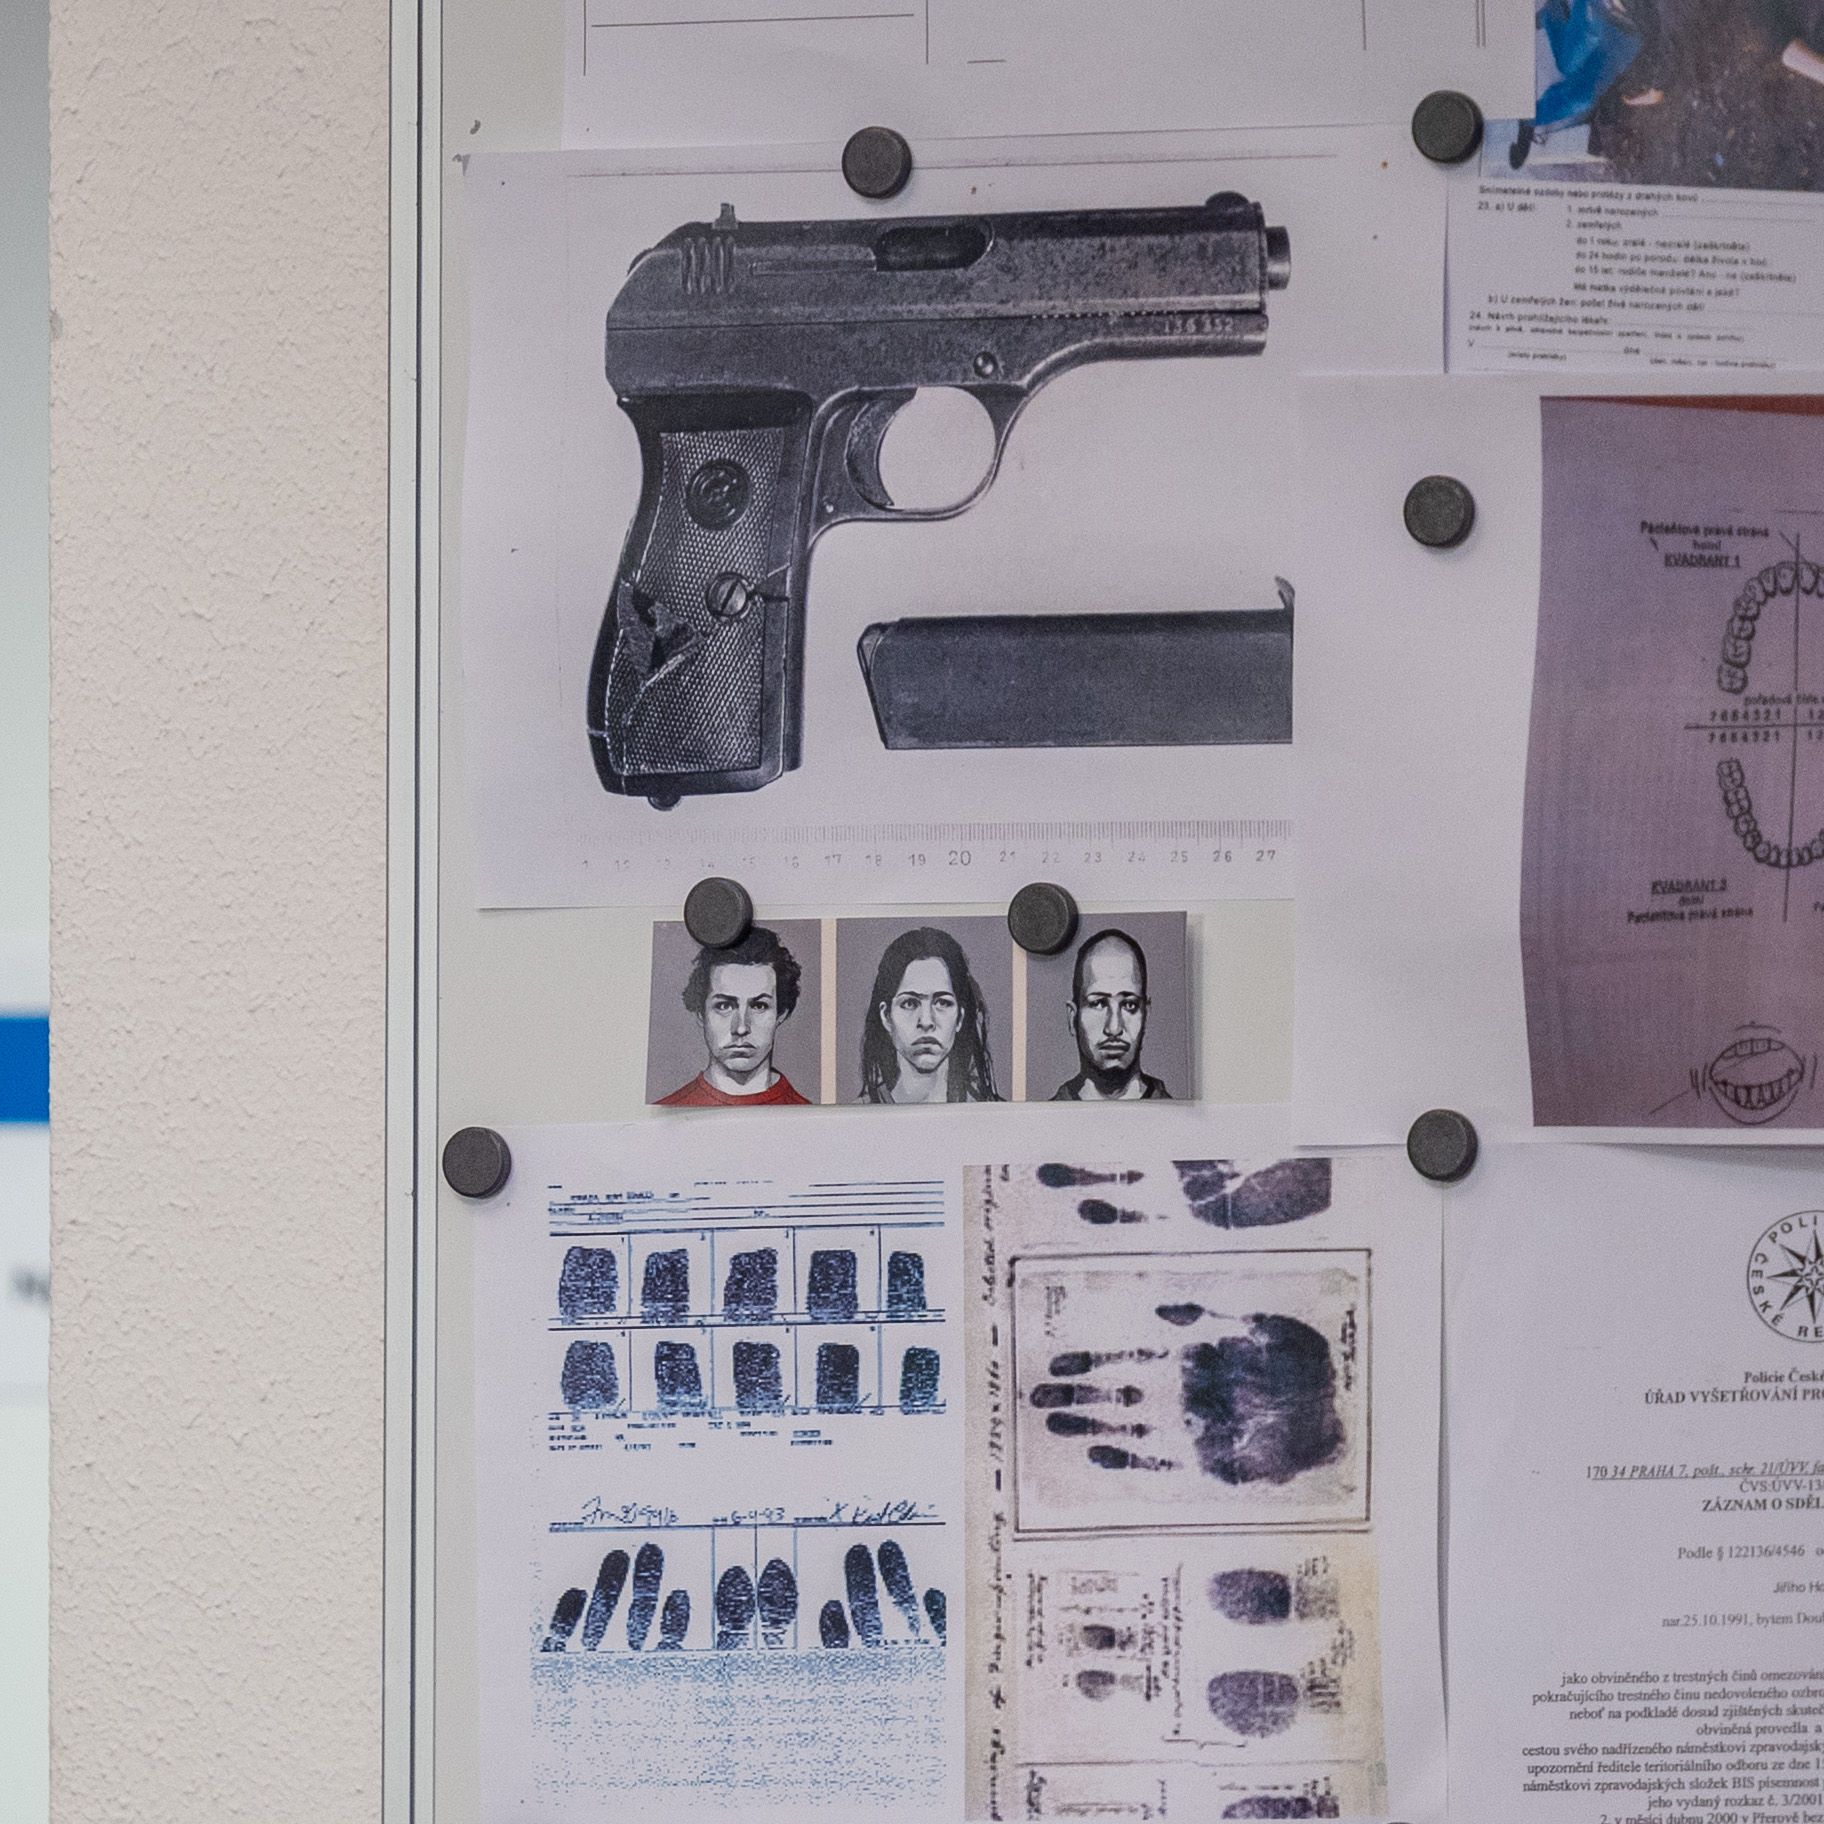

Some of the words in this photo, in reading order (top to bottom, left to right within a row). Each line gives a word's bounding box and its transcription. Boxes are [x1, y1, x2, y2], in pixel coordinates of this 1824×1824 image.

[949, 850, 972, 867] 20
[1744, 1370, 1785, 1383] Policie
[1645, 1386, 1685, 1405] ÚŘAD
[1690, 1385, 1798, 1404] VYŠETŘOVÁNÍ
[1586, 1466, 1607, 1479] 170
[1611, 1465, 1627, 1478] 34
[1629, 1464, 1676, 1478] PRAHA
[1702, 1497, 1768, 1512] ZÁZNAM
[1677, 1546, 1713, 1559] Podle
[1756, 1613, 1793, 1628] bytem
[1560, 1671, 1588, 1687] jako
[1591, 1671, 1660, 1684] obviněného
[1673, 1669, 1728, 1684] trestných
[1731, 1669, 1757, 1682] činů
[1532, 1689, 1614, 1706] pokračujícího
[1617, 1688, 1671, 1702] trestného
[1674, 1688, 1700, 1701] činu
[1704, 1687, 1788, 1700] nedovoleného
[1569, 1706, 1605, 1719] neboť
[1682, 1706, 1719, 1718] dosud
[1696, 1723, 1752, 1736] obviněná
[1755, 1721, 1808, 1738] provedla
[1522, 1744, 1560, 1756] cestou
[1563, 1743, 1599, 1756] svého
[1602, 1742, 1673, 1755] nadřízeného
[1676, 1740, 1746, 1754] náměstkovi
[1527, 1761, 1593, 1777] upozornění
[1597, 1760, 1642, 1773] ředitele
[1645, 1759, 1722, 1773] teritoriálního
[1725, 1758, 1769, 1771] odboru
[1788, 1757, 1810, 1770] dne
[1523, 1778, 1591, 1792] náměstkovi
[1594, 1777, 1685, 1794] zpravodajských
[1689, 1777, 1728, 1790] složek
[1732, 1776, 1754, 1790] BIS
[1647, 1794, 1672, 1811] jeho
[1676, 1795, 1721, 1811] vydaný
[1724, 1794, 1765, 1807] rozkaz
[1707, 1811, 1738, 1824] 2000
